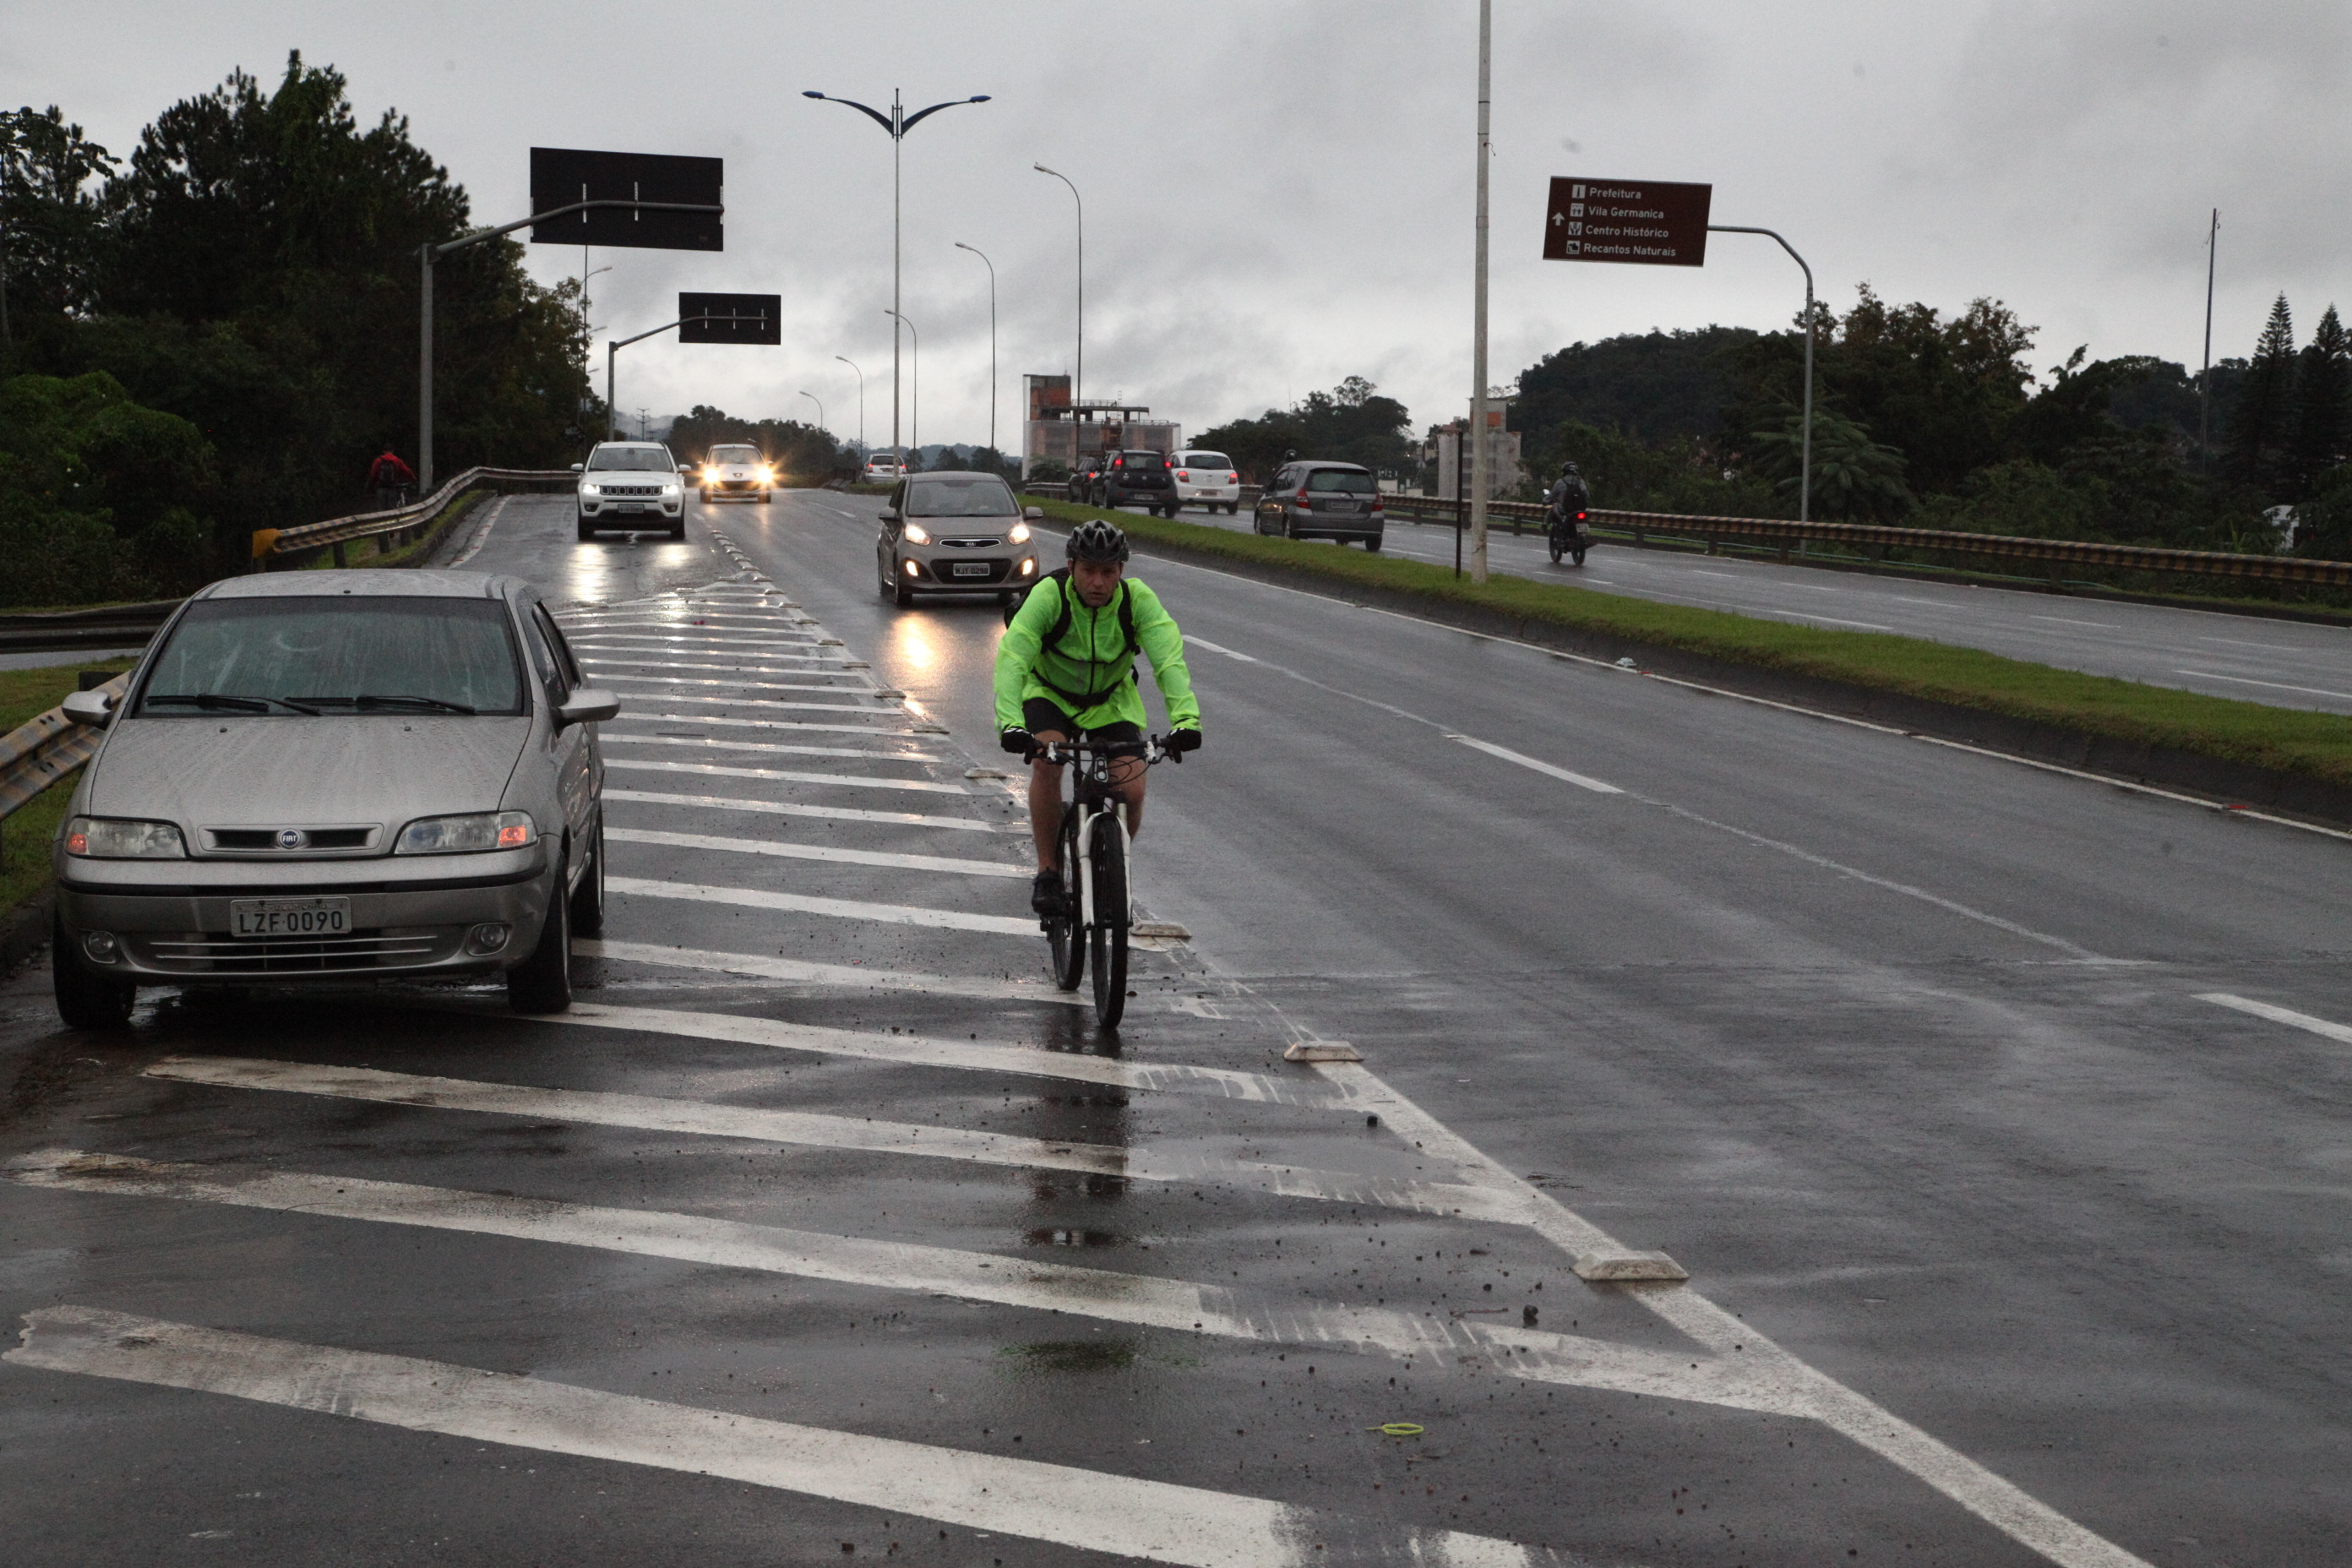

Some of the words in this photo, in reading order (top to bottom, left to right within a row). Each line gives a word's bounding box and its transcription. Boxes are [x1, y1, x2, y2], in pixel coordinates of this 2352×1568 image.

[1589, 188, 1642, 199] Prefeitura
[1588, 206, 1607, 216] Vila
[1586, 225, 1620, 236] Centro
[1623, 227, 1669, 237] Histórico
[1584, 243, 1631, 254] Recantos
[1633, 245, 1676, 257] Naturais
